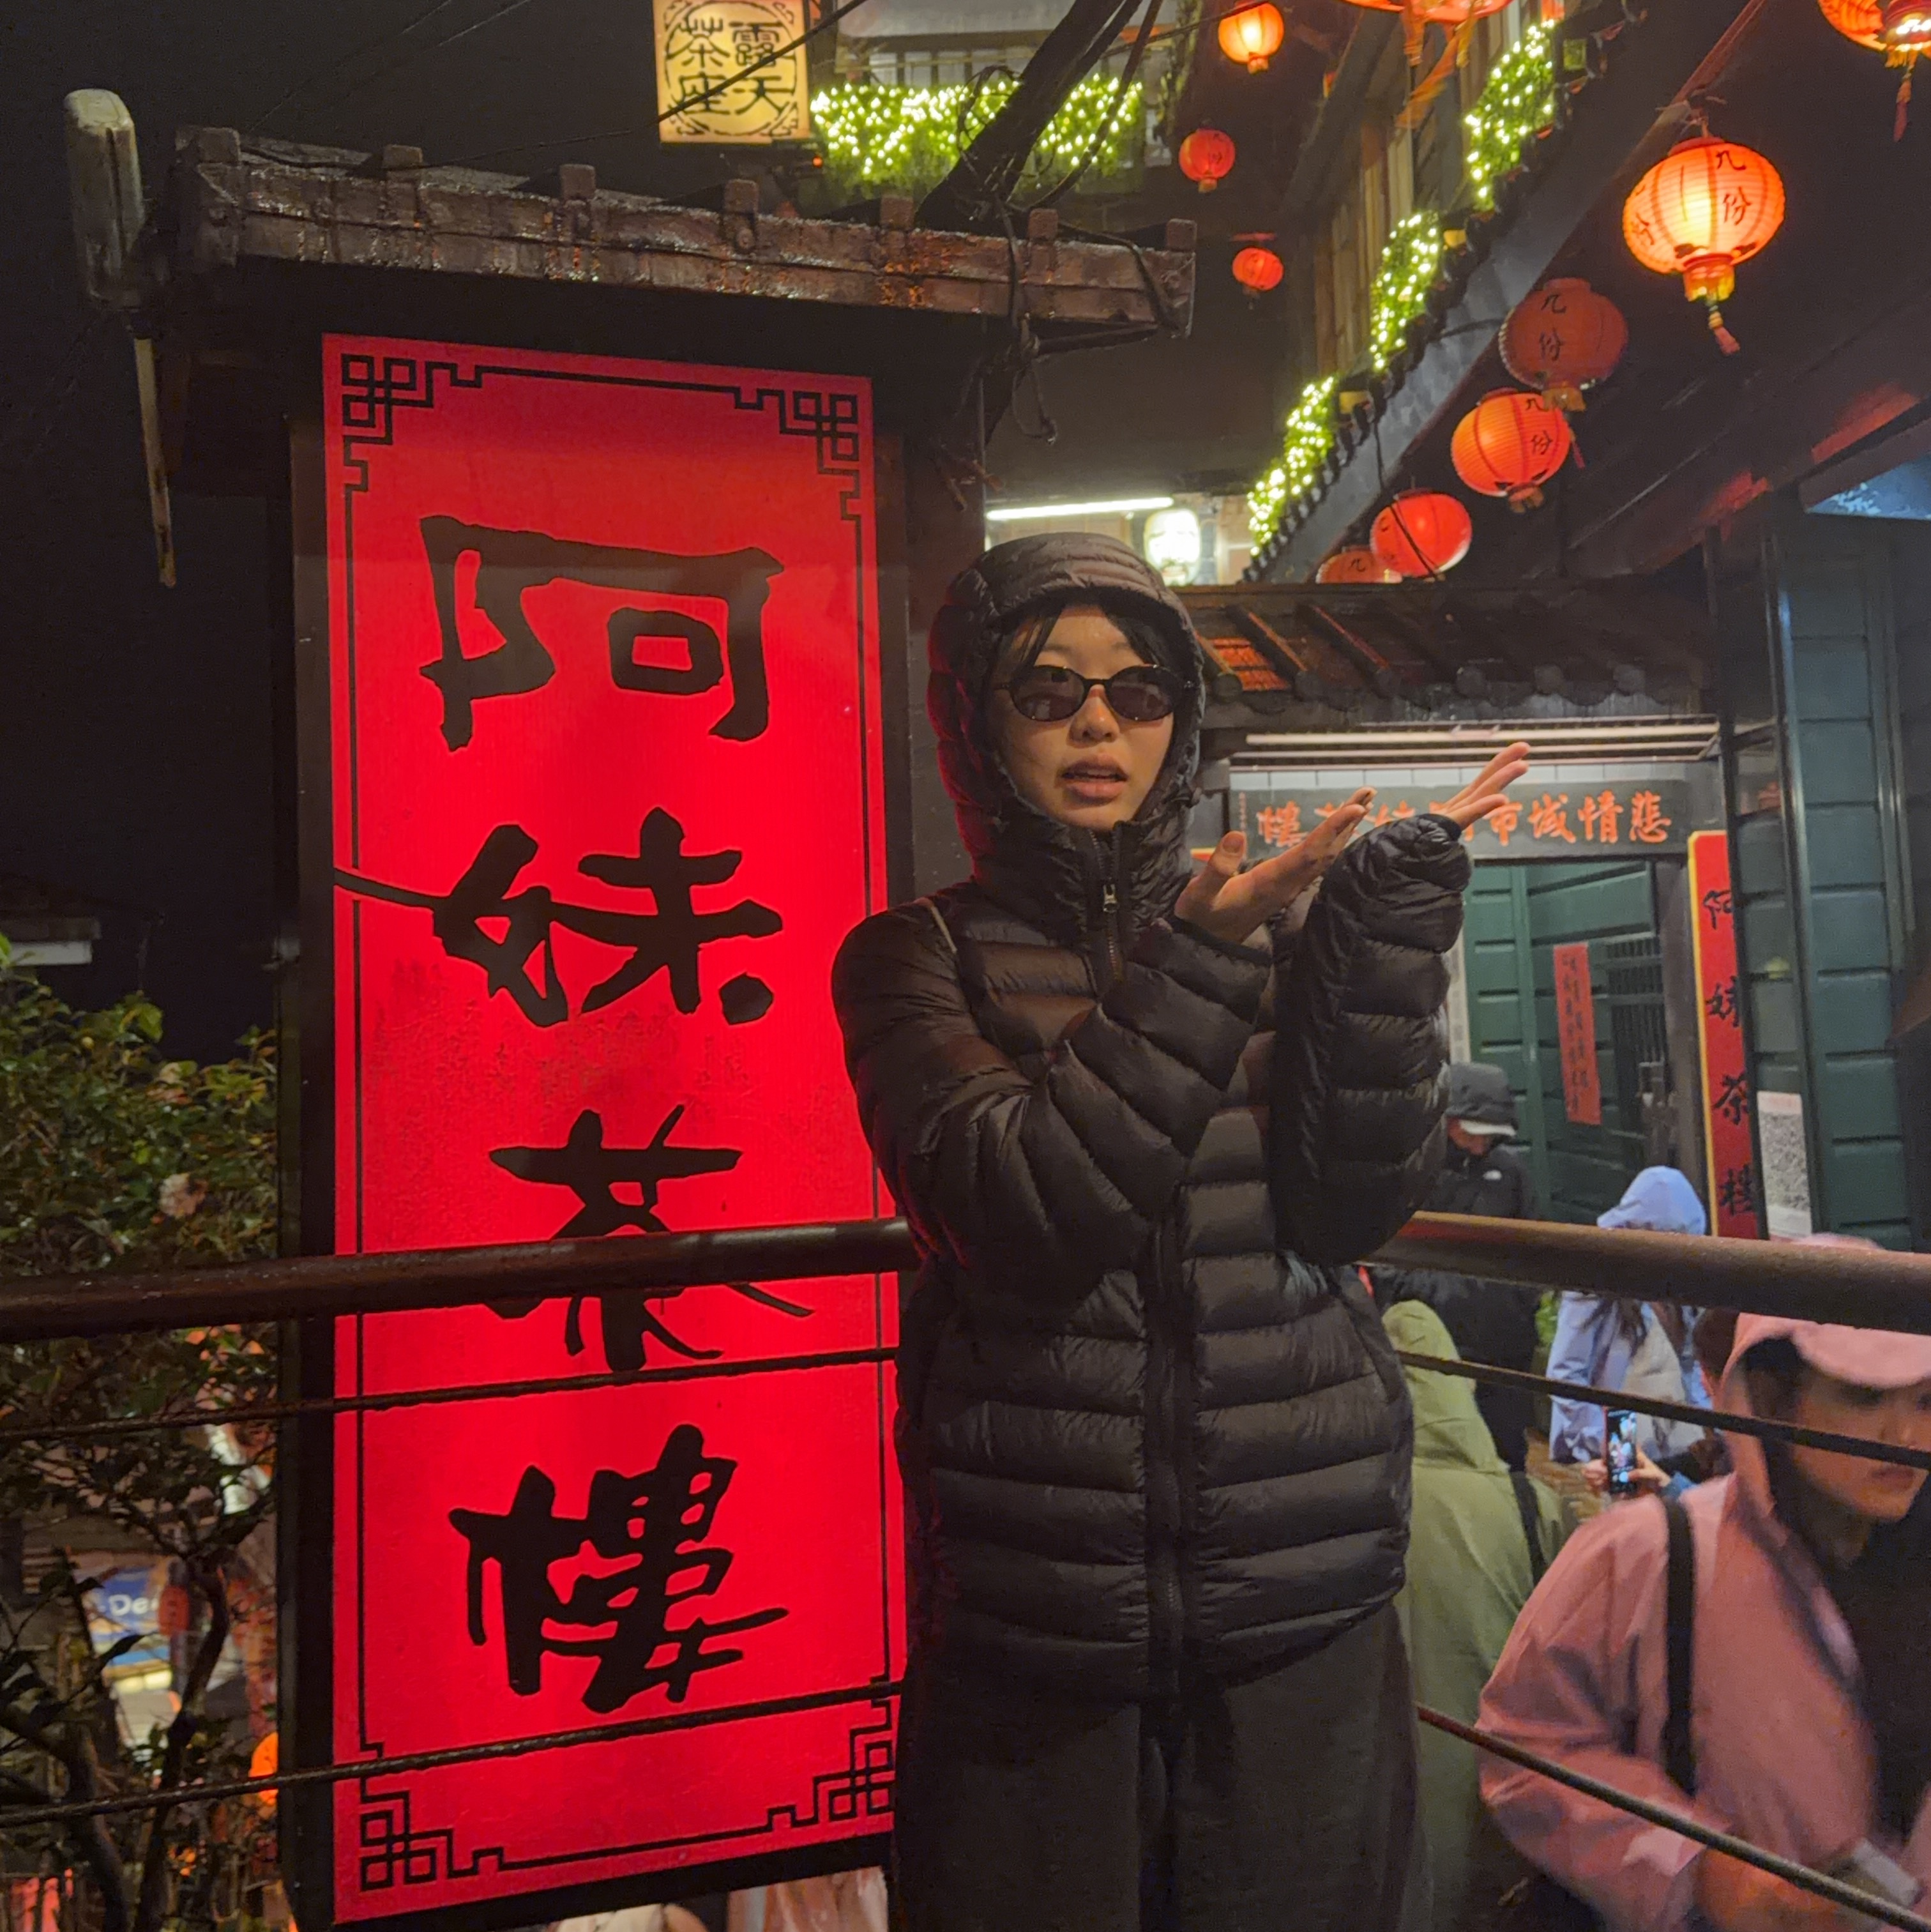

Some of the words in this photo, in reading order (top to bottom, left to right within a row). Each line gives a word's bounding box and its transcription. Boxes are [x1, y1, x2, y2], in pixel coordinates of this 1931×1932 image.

[666, 16, 731, 116] 茶座
[729, 20, 797, 116] 露天
[1716, 149, 1752, 225] 九份
[1538, 293, 1568, 361] 九份
[1525, 397, 1554, 455] 九份
[1255, 789, 1672, 849] 悲情城市樓
[418, 513, 815, 1714] 阿妹茶樓
